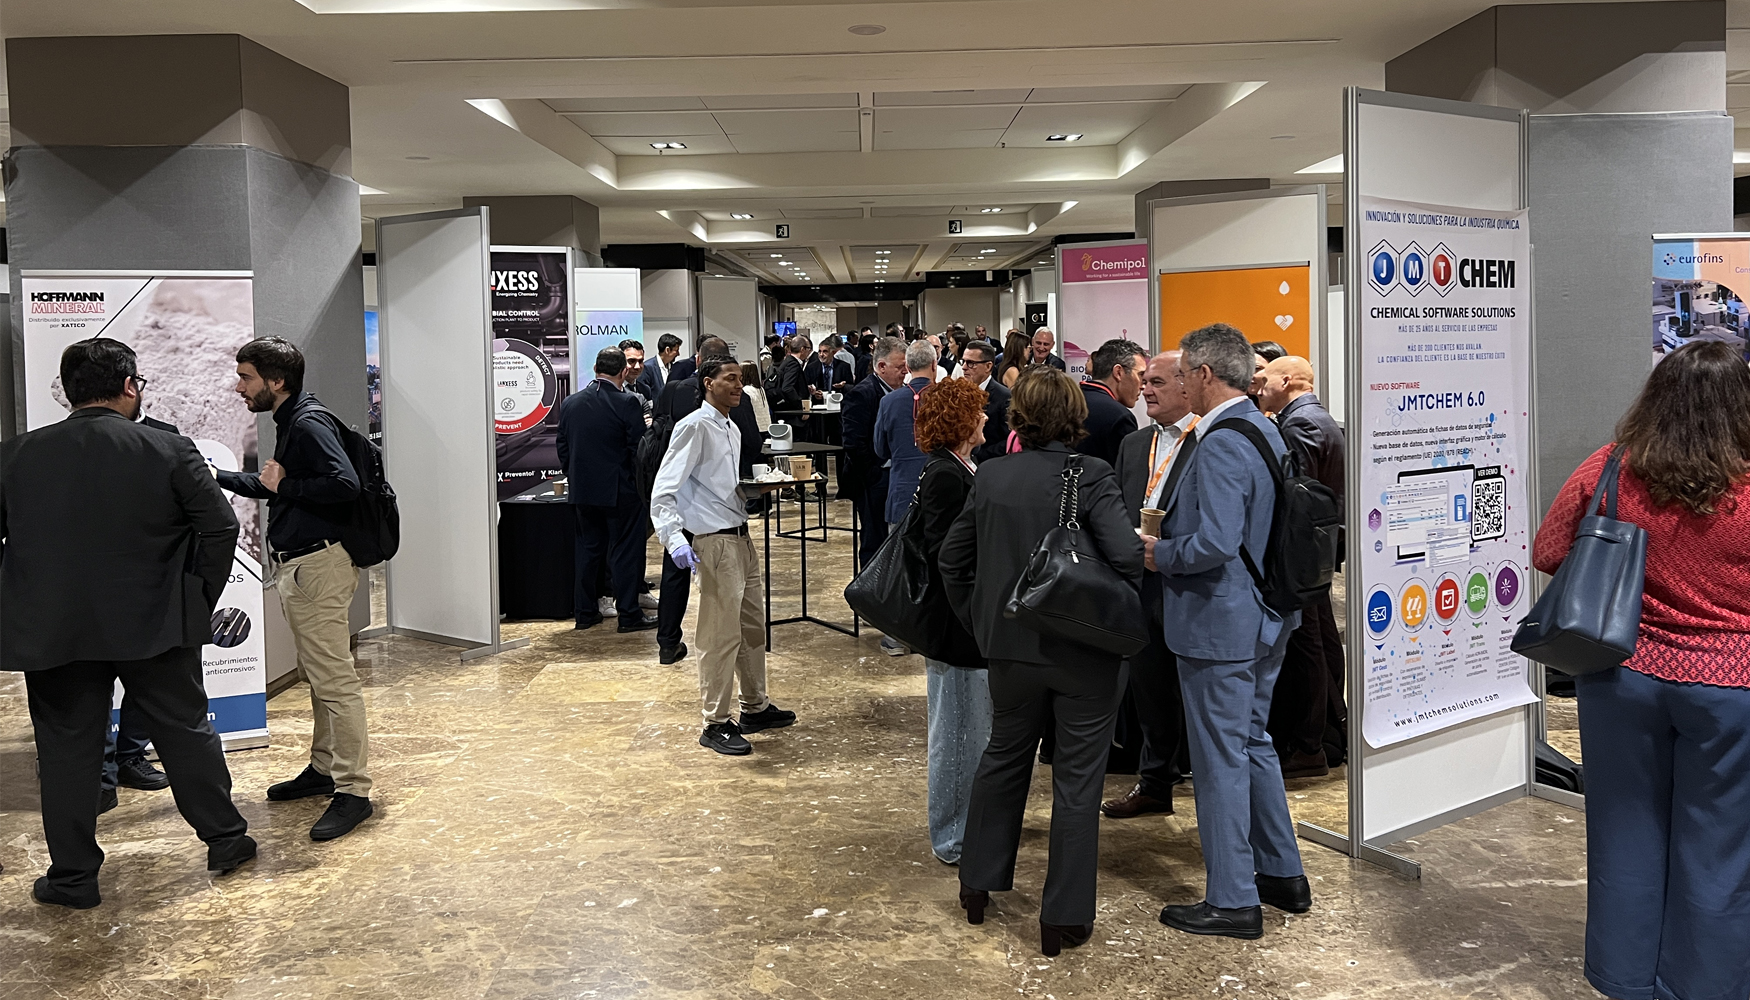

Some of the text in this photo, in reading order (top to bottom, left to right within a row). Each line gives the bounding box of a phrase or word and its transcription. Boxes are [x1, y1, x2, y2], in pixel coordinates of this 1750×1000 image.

[1366, 210, 1520, 230] INNOVACIÓN Y SOLUCIONES PARA LA INDUSTRIA QUÍMICA
[1092, 257, 1146, 271] Chemipol
[1679, 253, 1724, 264] eurofins
[31, 292, 104, 302] HOFFMANN
[32, 302, 105, 314] MINERAL
[1370, 307, 1516, 318] CHEMICAL SOFTWARE SOLUTIONS
[1391, 382, 1420, 390] SOFTWARE
[1398, 391, 1485, 411] JMTCHEM 6.0
[203, 656, 258, 667] Recubrimientos
[205, 666, 256, 676] anticorrosivos
[1394, 693, 1500, 727] www.jmtchemsolutions.com
